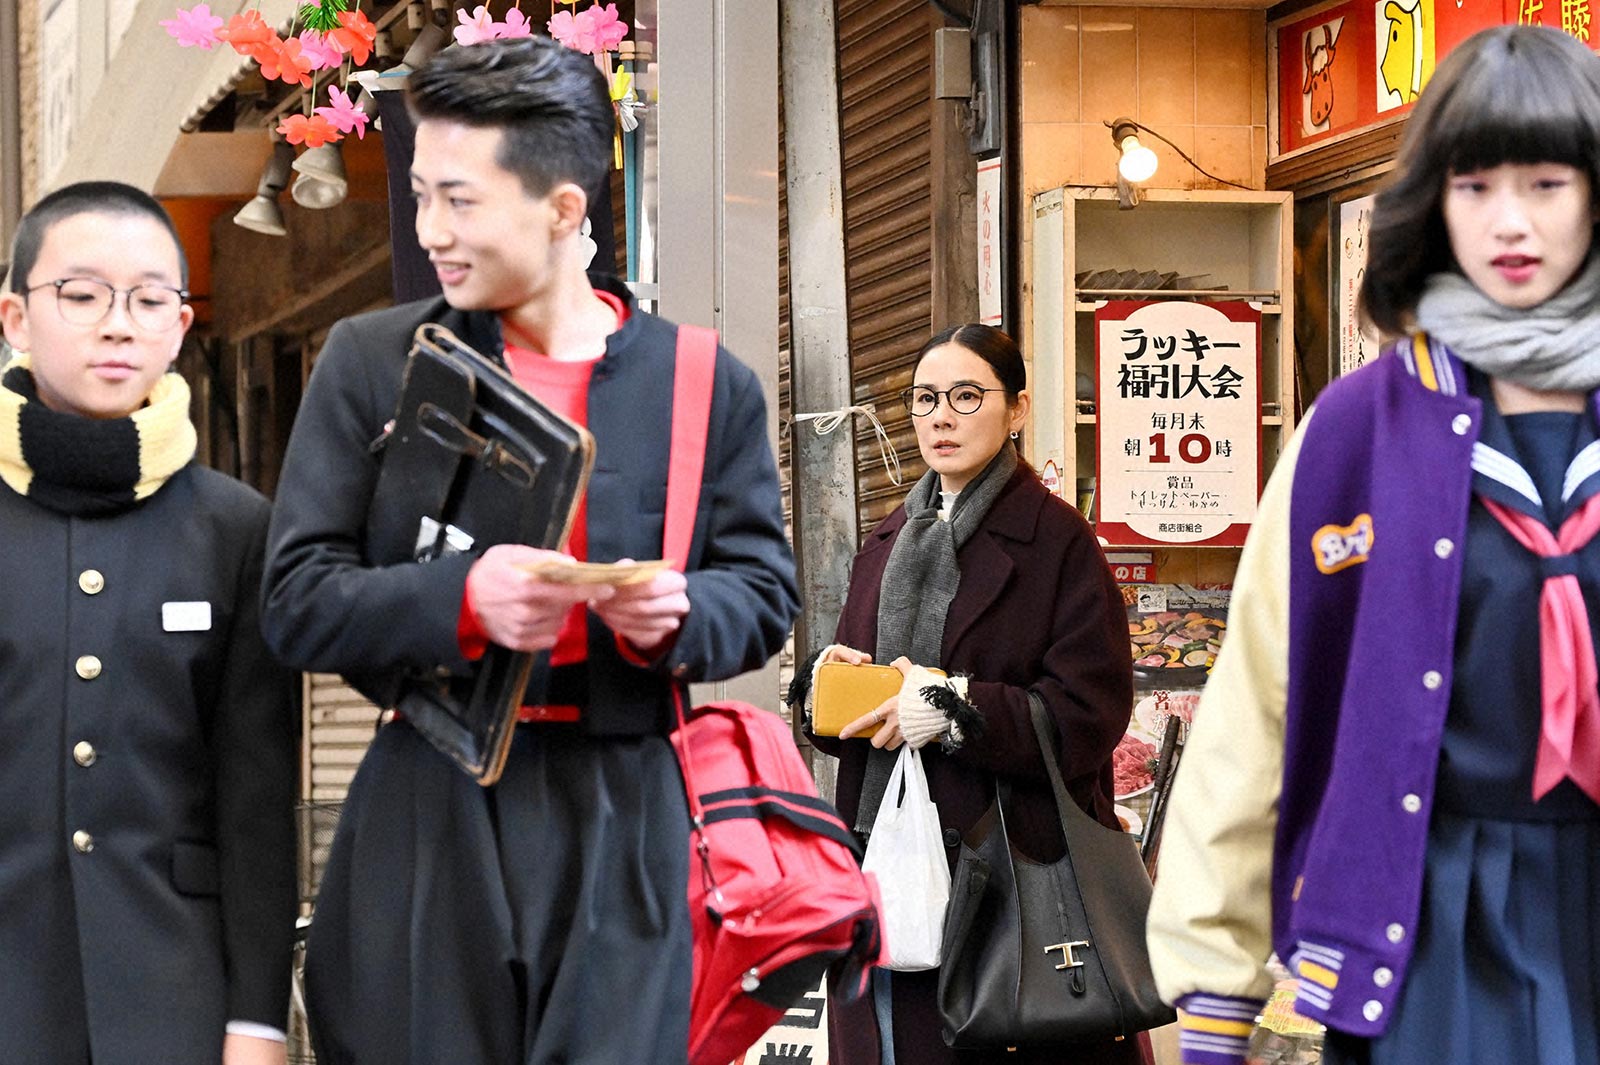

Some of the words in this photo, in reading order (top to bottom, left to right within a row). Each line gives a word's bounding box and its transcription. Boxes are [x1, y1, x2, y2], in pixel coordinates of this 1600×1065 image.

[1120, 328, 1241, 361] ラッキー
[1117, 363, 1244, 399] 福引大会
[1151, 412, 1205, 430] 毎月末
[1166, 475, 1194, 489] 賞品
[1158, 523, 1203, 533] 商店街組合
[1115, 566, 1147, 581] の店
